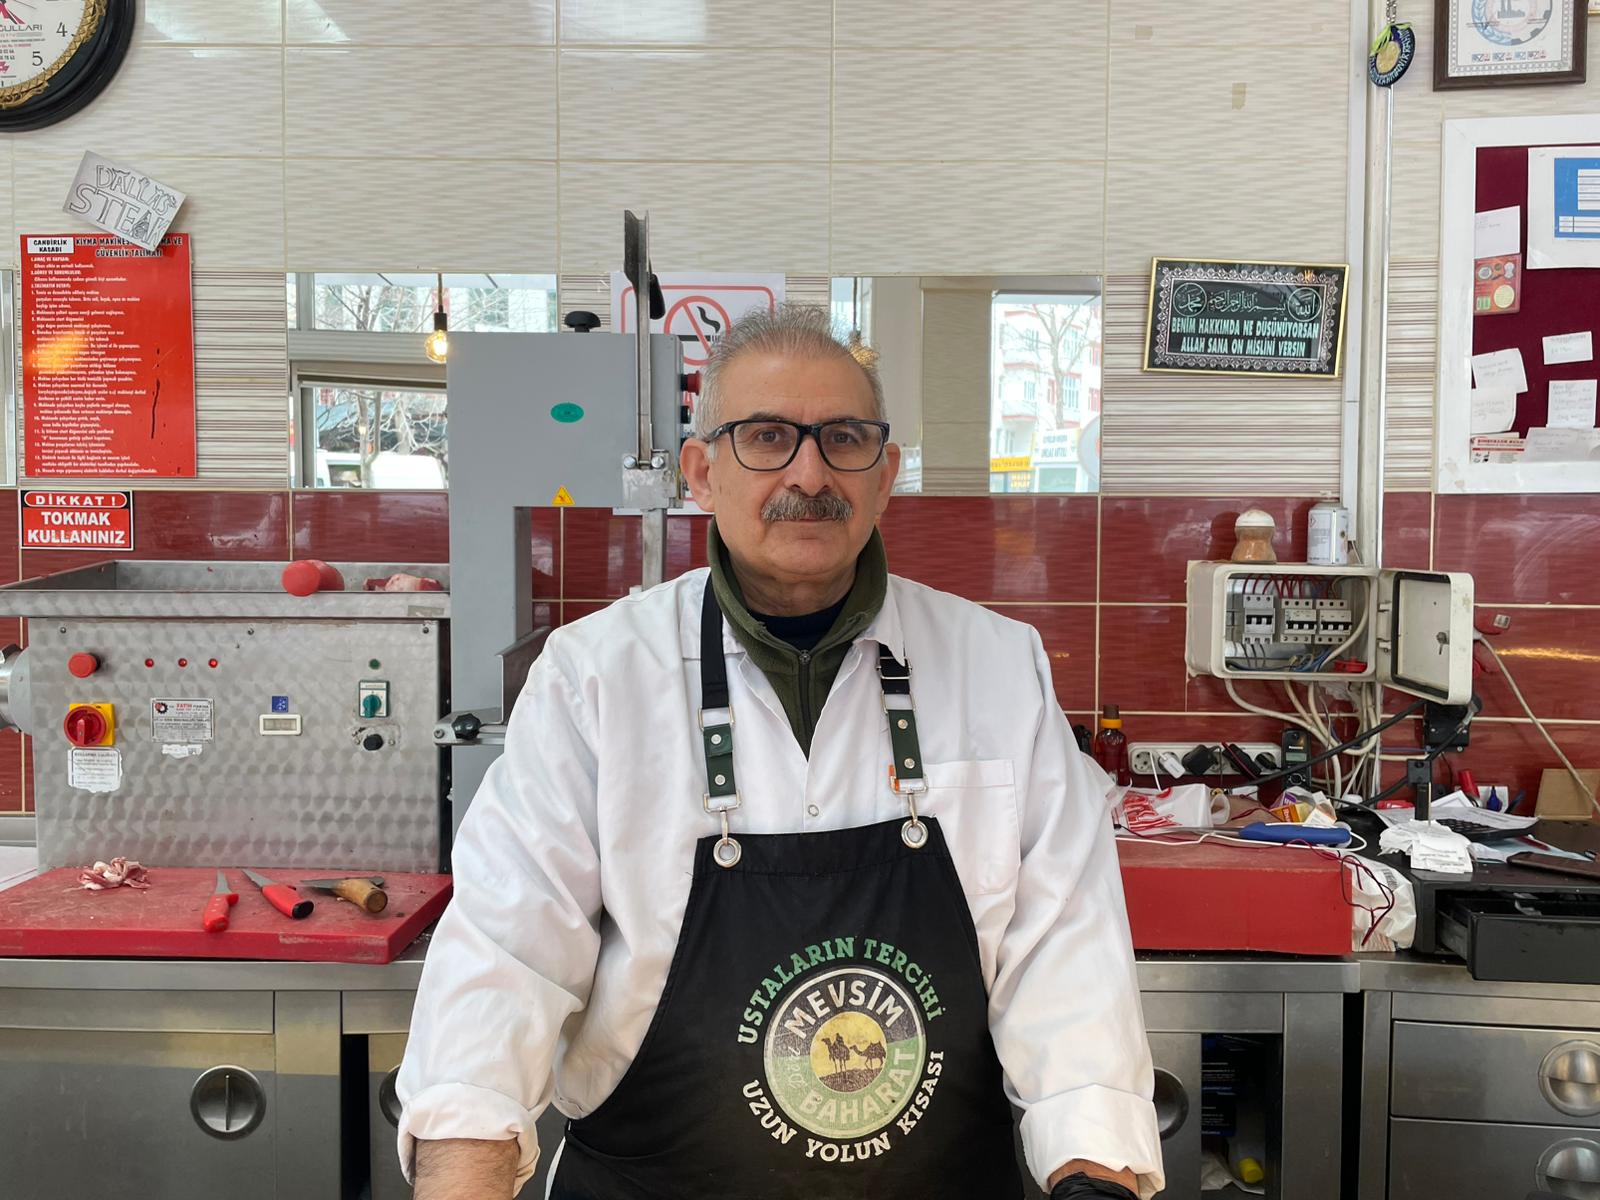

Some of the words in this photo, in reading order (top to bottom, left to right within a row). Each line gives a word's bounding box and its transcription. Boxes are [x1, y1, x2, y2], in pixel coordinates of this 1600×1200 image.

[56, 22, 68, 37] 4
[32, 51, 43, 66] 5
[96, 164, 177, 216] DALLAS
[69, 183, 171, 247] STEAK
[174, 236, 183, 245] VE
[1171, 316, 1196, 334] BENİM
[1198, 318, 1240, 336] HAKKIMDA
[1242, 320, 1253, 336] NE
[1180, 336, 1206, 353] ALLAH
[1207, 338, 1229, 354] SANA
[1231, 339, 1245, 355] ON
[1245, 336, 1277, 356] MİSLİNİ
[35, 493, 105, 507] DİKKAT
[40, 511, 111, 527] TOKMAK
[27, 529, 126, 545] KULLANINIZ
[737, 937, 855, 1044] USTALARIN
[864, 938, 946, 1021] TERCİHİ
[784, 980, 905, 1040] MEVSİM
[799, 1047, 916, 1125] BAHARAT
[742, 1079, 798, 1145] UZUN
[805, 1131, 892, 1163] YOLUN
[896, 1050, 944, 1136] KISASI
